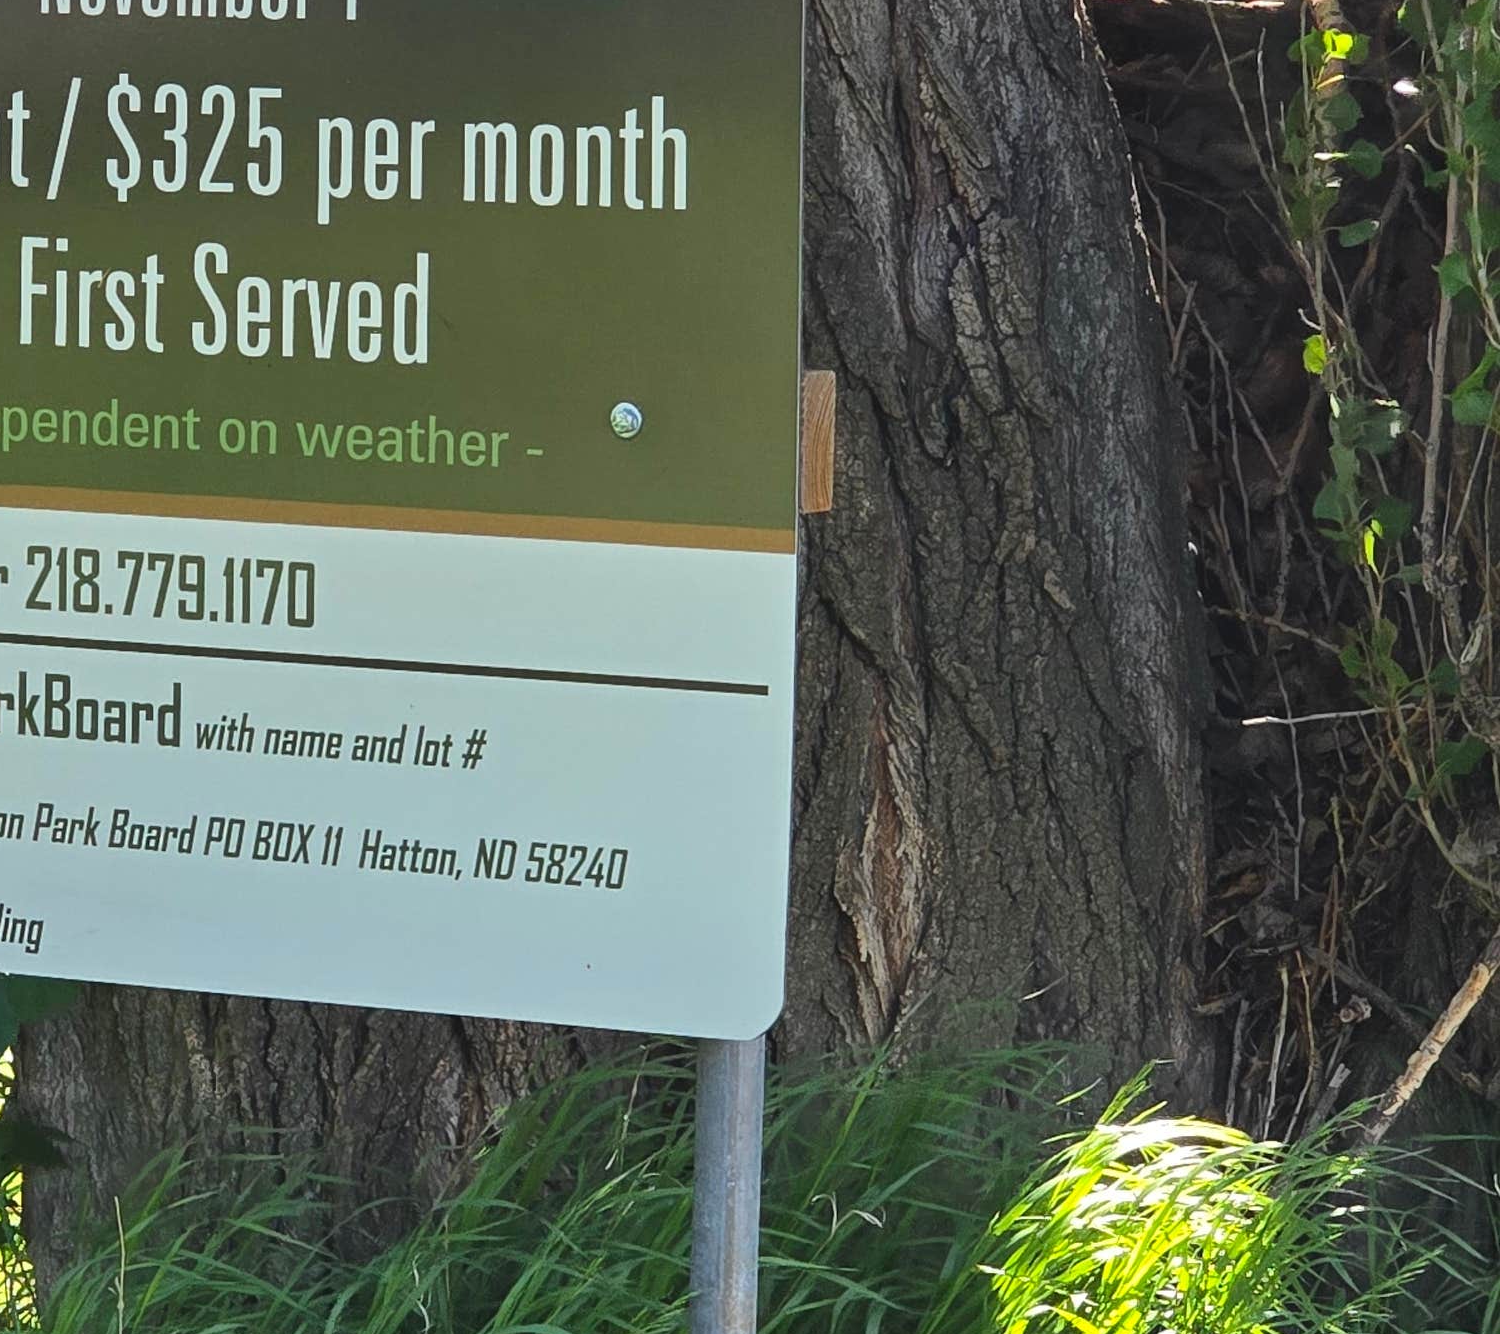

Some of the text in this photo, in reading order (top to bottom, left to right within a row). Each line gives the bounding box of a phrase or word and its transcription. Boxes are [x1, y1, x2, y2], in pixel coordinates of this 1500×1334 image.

[47, 77, 81, 199] /
[107, 73, 282, 202] $325
[318, 118, 435, 224] per
[463, 96, 686, 210] month
[20, 237, 164, 353] First
[192, 243, 429, 364] Served
[220, 419, 276, 454] on
[296, 415, 509, 467] weather
[25, 546, 315, 628] 218.779.1170
[197, 713, 255, 753] with
[263, 729, 343, 759] name
[352, 724, 407, 764] and
[414, 725, 453, 767] lot
[462, 729, 487, 769] #
[33, 803, 100, 846] Park
[108, 809, 197, 854] Board
[204, 817, 245, 858] PO
[252, 820, 315, 864] BOX
[321, 826, 343, 866] 11
[359, 829, 462, 880] Hatton,
[474, 838, 517, 880] ND
[525, 842, 628, 889] 58240
